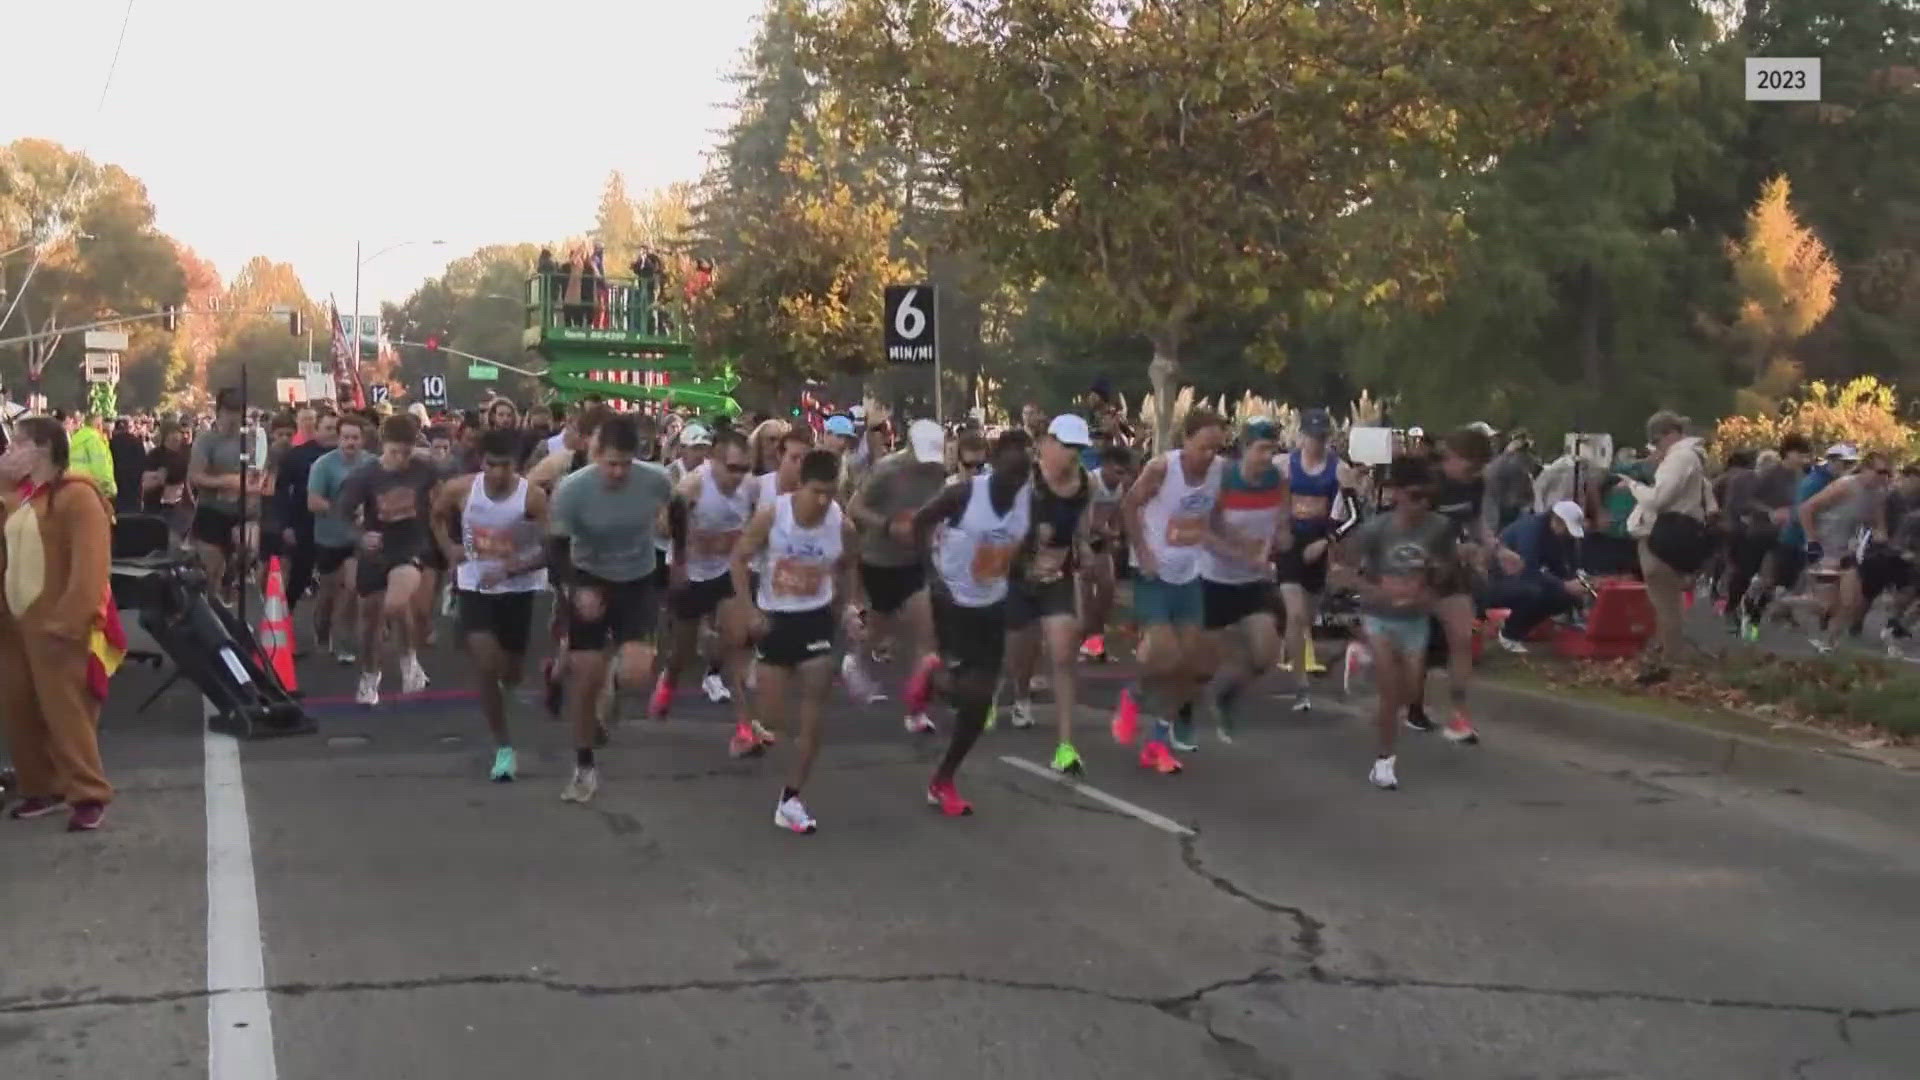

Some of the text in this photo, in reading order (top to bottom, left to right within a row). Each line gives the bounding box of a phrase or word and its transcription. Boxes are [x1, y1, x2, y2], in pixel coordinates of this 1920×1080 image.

[895, 288, 926, 339] 6
[890, 345, 932, 362] MIN/MI
[372, 387, 388, 403] 12
[423, 376, 443, 397] 10
